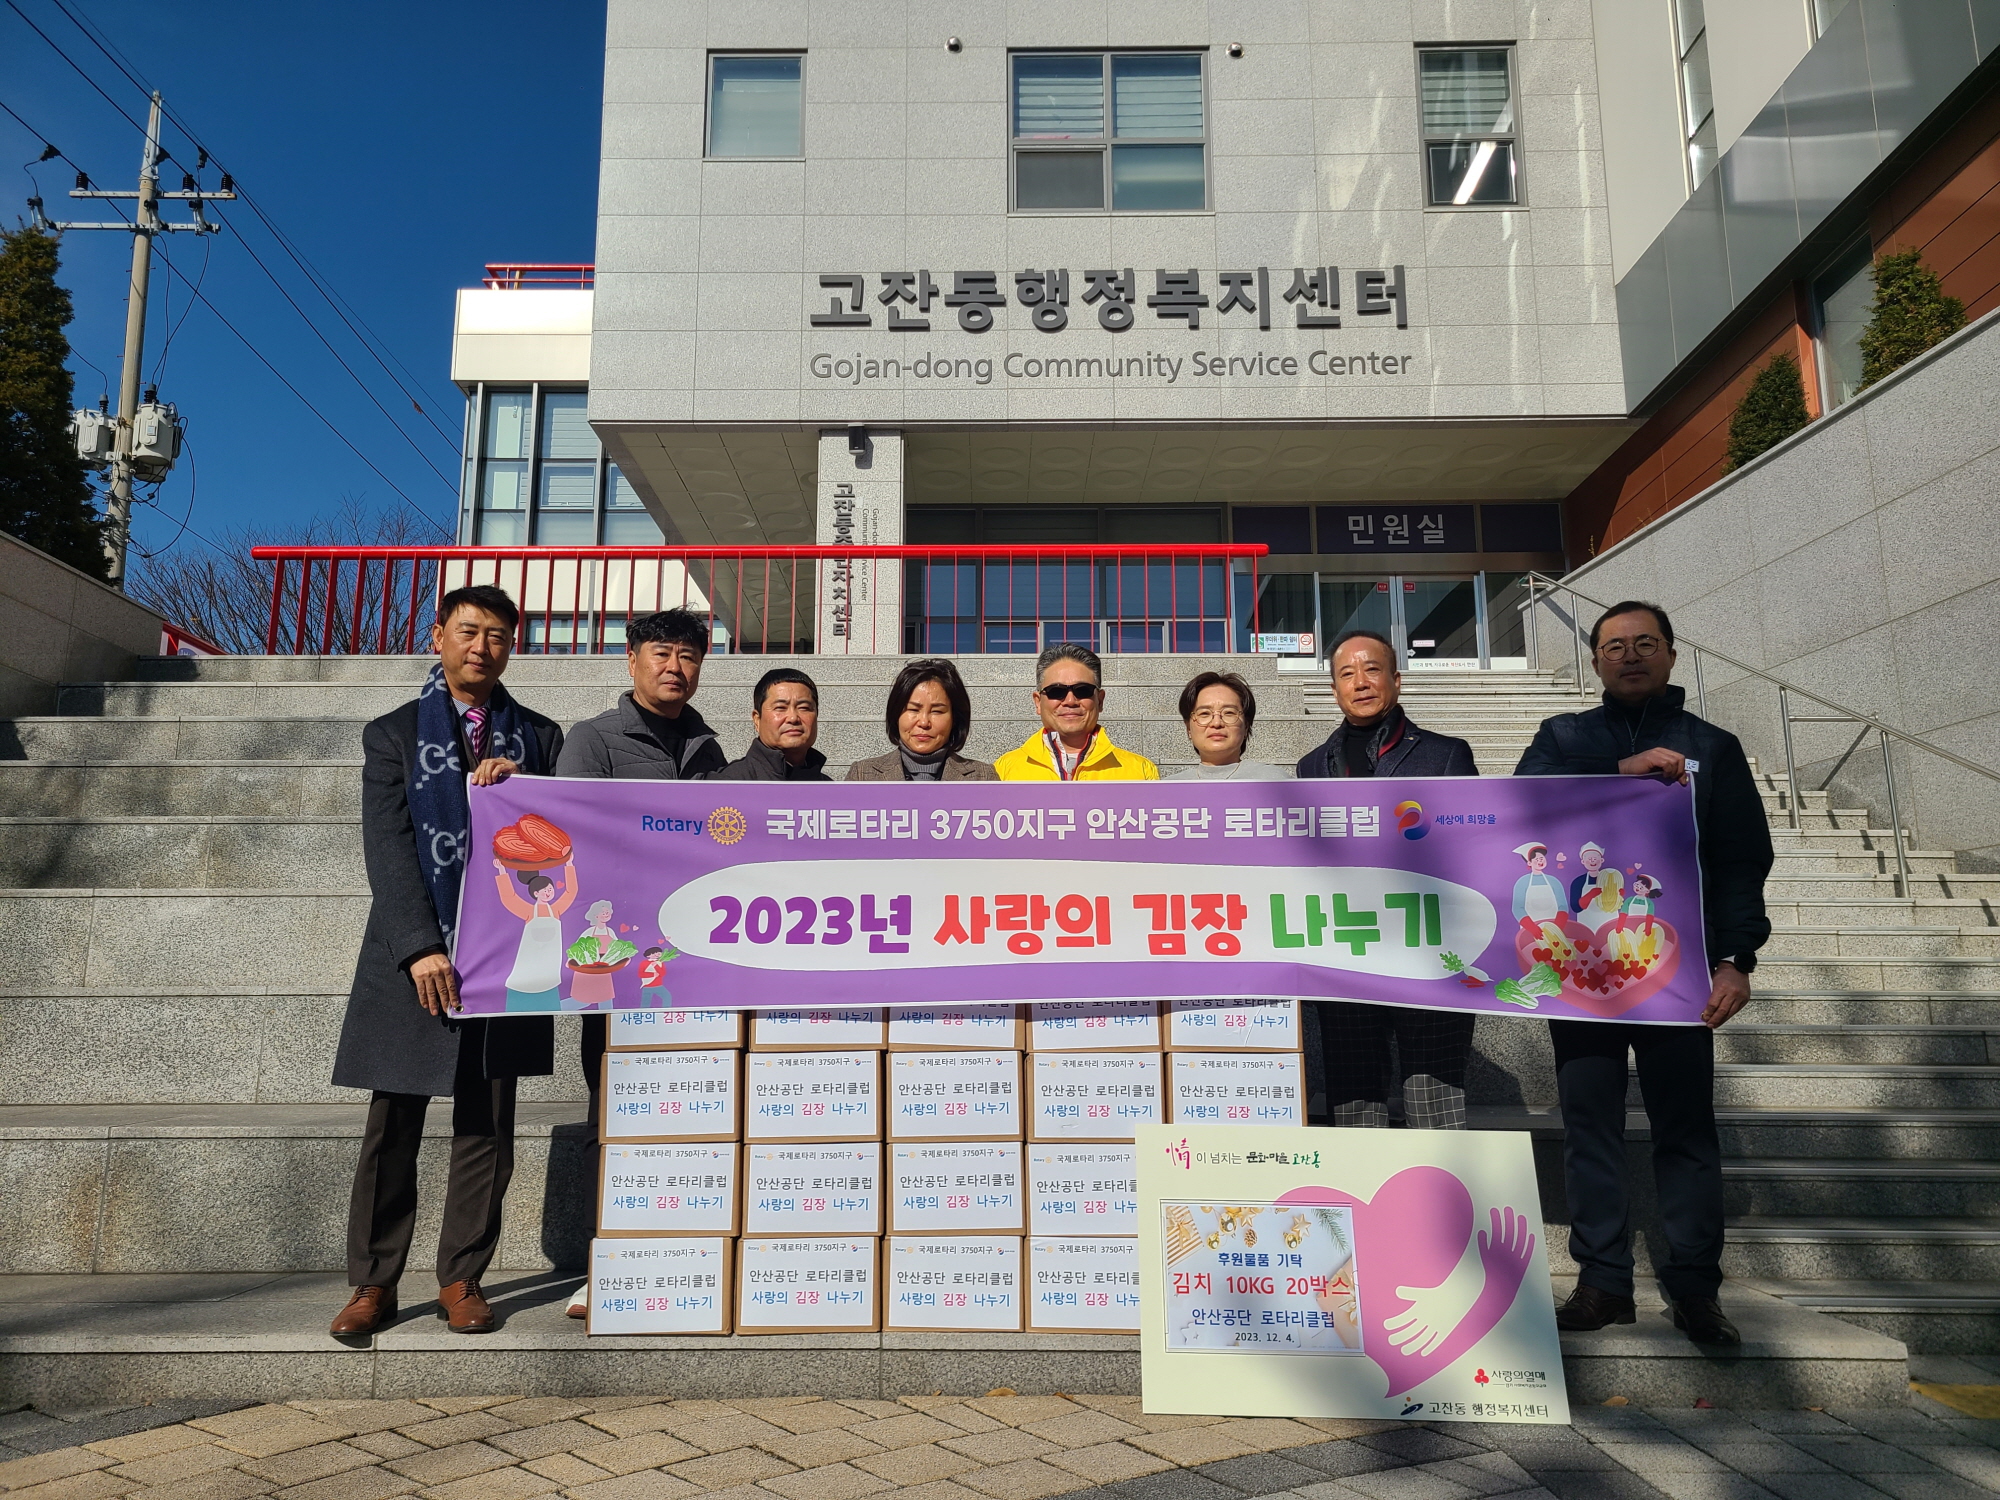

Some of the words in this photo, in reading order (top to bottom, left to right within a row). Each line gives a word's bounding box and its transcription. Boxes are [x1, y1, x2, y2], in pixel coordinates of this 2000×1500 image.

[810, 265, 1408, 332] 고잔동행정복지센터
[810, 352, 993, 385] Gojan-dong
[1004, 351, 1182, 383] Community
[1192, 350, 1298, 377] Service
[1308, 349, 1412, 376] Center
[871, 508, 879, 546] Gojan-don
[1348, 514, 1444, 544] 민원실
[641, 814, 703, 835] Rotary
[766, 808, 919, 841] 국제로타리
[930, 808, 1077, 840] 3750지구
[1086, 807, 1212, 840] 안산공단
[1224, 805, 1381, 839] 로타리클럽
[1435, 814, 1464, 825] 세상에
[1467, 814, 1497, 825] 희망을
[708, 893, 912, 954] 2023년
[933, 893, 1112, 955] 사랑의
[1132, 893, 1248, 956] 김장
[1269, 892, 1442, 956] 나누기
[620, 1012, 656, 1025] 사랑의
[663, 1011, 687, 1024] 김장
[693, 1010, 728, 1022] 나누기
[766, 1012, 801, 1024] 사랑의
[809, 1012, 832, 1023] 김장
[839, 1011, 873, 1024] 나누기
[899, 1012, 934, 1024] 사랑의
[942, 1013, 964, 1025] 김장
[971, 1014, 1006, 1027] 나누기
[1042, 1016, 1077, 1029] 사랑의
[1084, 1015, 1107, 1027] 김장
[1114, 1014, 1148, 1026] 나누기
[1181, 1014, 1216, 1026] 사랑의
[1224, 1015, 1247, 1027] 김장
[1254, 1015, 1288, 1028] 나누기
[635, 1057, 672, 1065] 국제로타리
[676, 1056, 708, 1064] 3750지구
[777, 1058, 814, 1067] 국제로타리
[919, 1058, 955, 1067] 국제로타리
[1062, 1060, 1098, 1068] 국제로타리
[1103, 1060, 1134, 1068] 3750지구
[1242, 1061, 1273, 1069] 3750지구
[614, 1082, 661, 1095] 안산공단
[668, 1080, 727, 1093] 로타리클럽
[756, 1083, 804, 1096] 안산공단
[811, 1082, 869, 1095] 로타리클럽
[899, 1083, 946, 1096] 안산공단
[953, 1082, 1011, 1094] 로타리클럽
[1041, 1085, 1089, 1097] 안산공단
[1096, 1085, 1154, 1097] 로타리클럽
[1180, 1085, 1228, 1098] 안산공단
[1235, 1086, 1294, 1098] 로타리클럽
[616, 1102, 650, 1115] 사랑의
[659, 1102, 682, 1114] 김장
[690, 1100, 723, 1113] 나누기
[759, 1104, 793, 1116] 사랑의
[802, 1103, 825, 1115] 김장
[832, 1102, 866, 1115] 나누기
[902, 1103, 936, 1116] 사랑의
[945, 1103, 967, 1115] 김장
[975, 1102, 1009, 1114] 나누기
[1045, 1105, 1079, 1117] 사랑의
[1087, 1105, 1110, 1117] 김장
[1118, 1105, 1152, 1117] 나누기
[1184, 1105, 1218, 1118] 사랑의
[1227, 1106, 1250, 1118] 김장
[1258, 1106, 1292, 1119] 나누기
[634, 1150, 671, 1158] 국제로타리
[676, 1150, 707, 1158] 3750지구
[778, 1152, 816, 1160] 국제로타리
[820, 1151, 852, 1160] 3750지구
[921, 1150, 957, 1158] 국제로타리
[963, 1149, 994, 1157] 3750지구
[1057, 1155, 1094, 1163] 국제로타리
[1099, 1154, 1130, 1162] 3750지구
[1196, 1152, 1206, 1164] 이
[1210, 1152, 1242, 1164] 넘치는
[1292, 1151, 1321, 1168] 고잔동
[612, 1175, 659, 1188] 안산공단
[666, 1175, 726, 1188] 로타리클럽
[757, 1178, 805, 1190] 안산공단
[812, 1177, 871, 1190] 로타리클럽
[900, 1175, 948, 1188] 안산공단
[955, 1174, 1014, 1187] 로타리클럽
[1037, 1180, 1085, 1193] 안산공단
[1092, 1180, 1137, 1192] 로타리클
[613, 1196, 648, 1209] 사랑의
[656, 1196, 680, 1208] 김장
[688, 1196, 722, 1209] 나누기
[759, 1198, 794, 1211] 사랑의
[803, 1198, 826, 1211] 김장
[834, 1198, 868, 1211] 나누기
[903, 1196, 938, 1209] 사랑의
[947, 1195, 970, 1208] 김장
[977, 1194, 1011, 1207] 나누기
[1041, 1201, 1075, 1214] 사랑의
[1084, 1201, 1107, 1213] 김장
[1115, 1200, 1137, 1213] 나누
[620, 1250, 658, 1259] 국제로타리
[663, 1249, 696, 1257] 3750지구
[772, 1243, 810, 1252] 국제로타리
[814, 1243, 847, 1251] 3750지구
[919, 1246, 956, 1254] 국제로타리
[961, 1246, 993, 1254] 3750지구
[1058, 1245, 1096, 1253] 국제로타리
[1101, 1245, 1133, 1254] 3750지구
[1218, 1253, 1269, 1267] 후원물품
[1277, 1254, 1302, 1268] 기탁
[599, 1277, 647, 1290] 안산공단
[654, 1274, 715, 1289] 로타리클럽
[750, 1270, 798, 1283] 안산공단
[805, 1269, 866, 1283] 로타리클럽
[897, 1271, 945, 1284] 안산공단
[952, 1272, 1012, 1285] 로타리클럽
[1038, 1271, 1086, 1284] 안산공단
[1094, 1272, 1139, 1285] 로타리클
[1173, 1272, 1212, 1295] 김치
[1226, 1277, 1274, 1294] 10KG
[1286, 1275, 1351, 1297] 20박스
[602, 1298, 636, 1311] 사랑의
[645, 1298, 669, 1310] 김장
[677, 1296, 711, 1310] 나누기
[752, 1291, 787, 1304] 사랑의
[796, 1291, 820, 1304] 김장
[828, 1291, 862, 1304] 나누기
[900, 1292, 935, 1306] 사랑의
[944, 1293, 967, 1306] 김장
[975, 1294, 1009, 1307] 나누기
[1041, 1292, 1076, 1305] 사랑의
[1085, 1293, 1108, 1306] 김장
[1117, 1293, 1140, 1306] 나누
[1192, 1308, 1251, 1326] 안산공단
[1261, 1310, 1334, 1328] 로타리클럽
[1235, 1332, 1261, 1342] 2023.
[1266, 1332, 1281, 1342] 12.
[1286, 1333, 1295, 1343] 4.
[1491, 1370, 1546, 1382] 사랑의열매
[1429, 1402, 1466, 1415] 고잔동
[1472, 1402, 1549, 1418] 행정복지센터
